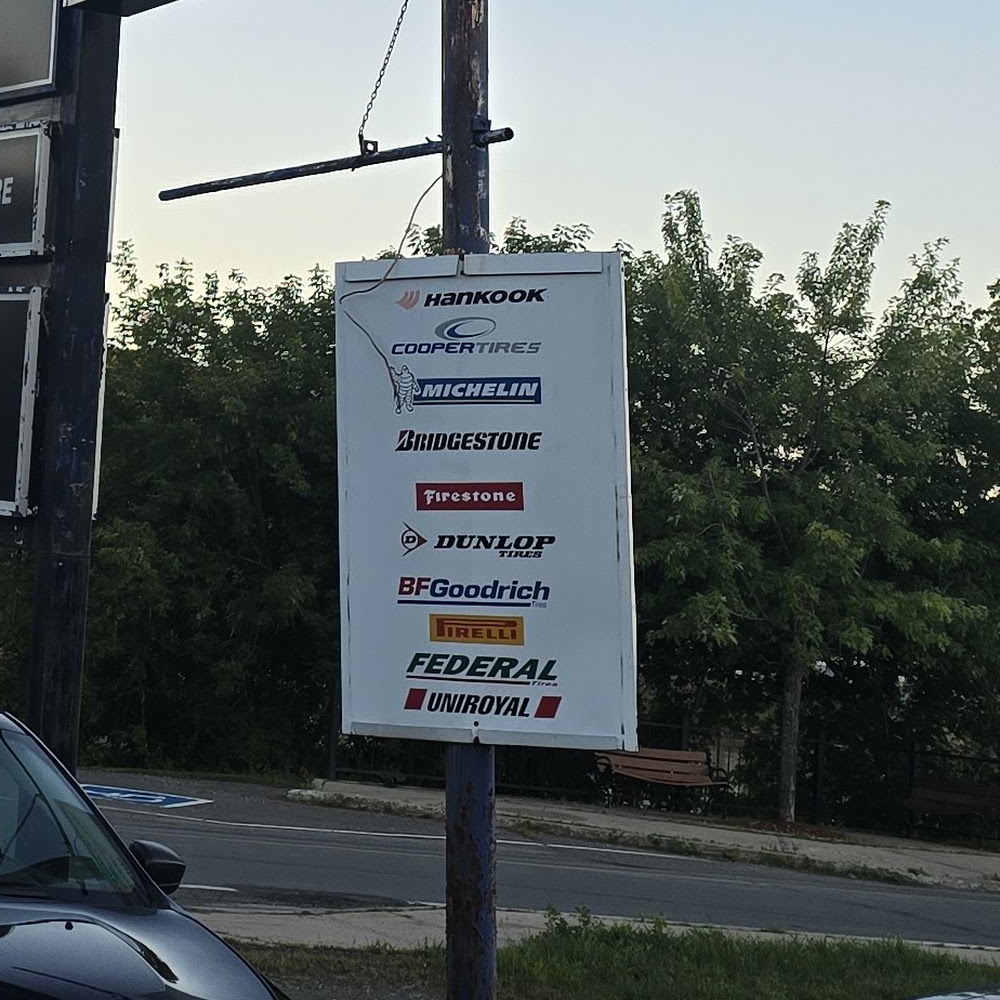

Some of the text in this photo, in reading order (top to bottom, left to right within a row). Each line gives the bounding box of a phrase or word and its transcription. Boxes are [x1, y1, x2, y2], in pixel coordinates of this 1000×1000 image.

[421, 382, 539, 398] MICHELIN
[395, 430, 542, 452] BRIDGESTONE
[424, 489, 516, 505] Firestone
[433, 535, 556, 550] DUNLOP
[398, 576, 550, 600] BFGoodrich
[436, 617, 518, 640] PIRELLI
[406, 653, 558, 681] FEDERAL
[427, 692, 530, 717] UNIROYAL
